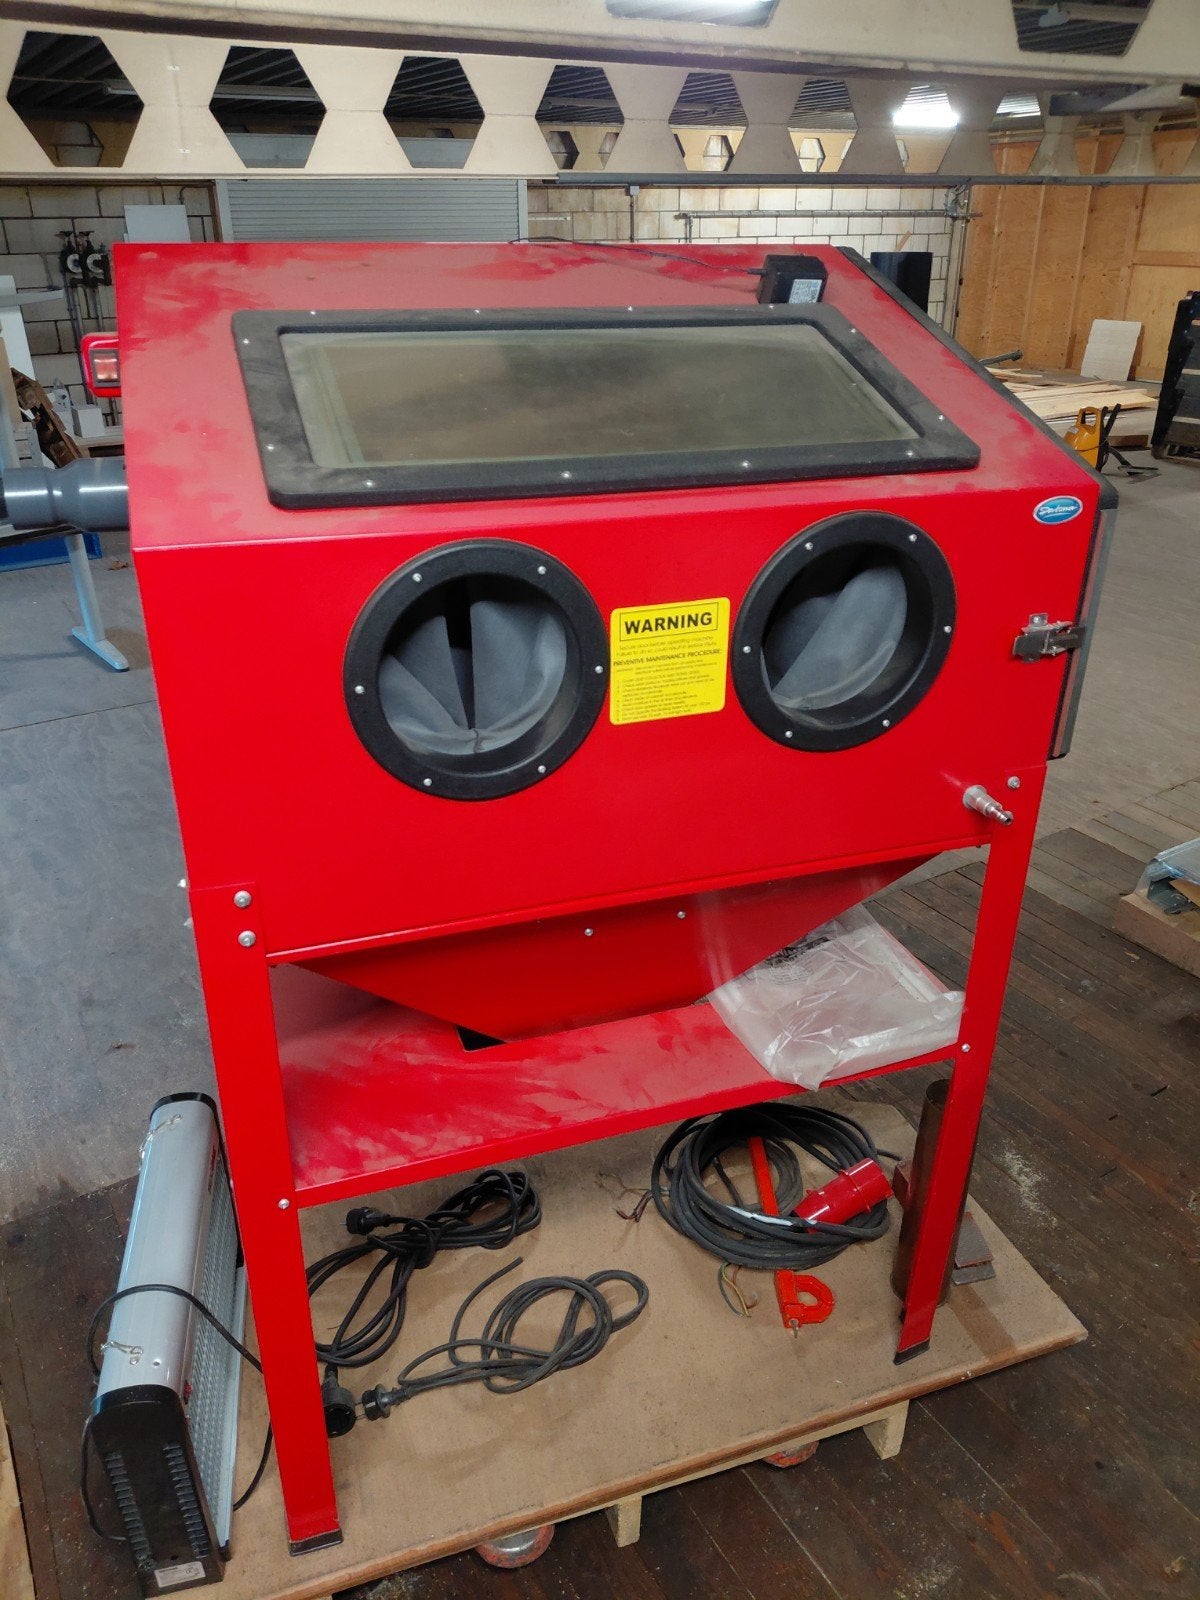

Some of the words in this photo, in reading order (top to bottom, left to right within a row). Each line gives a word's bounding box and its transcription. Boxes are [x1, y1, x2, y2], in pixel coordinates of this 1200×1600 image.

[624, 612, 712, 635] WARNING
[613, 657, 643, 666] PREVENTIVE
[646, 652, 684, 662] MAINTENANCE
